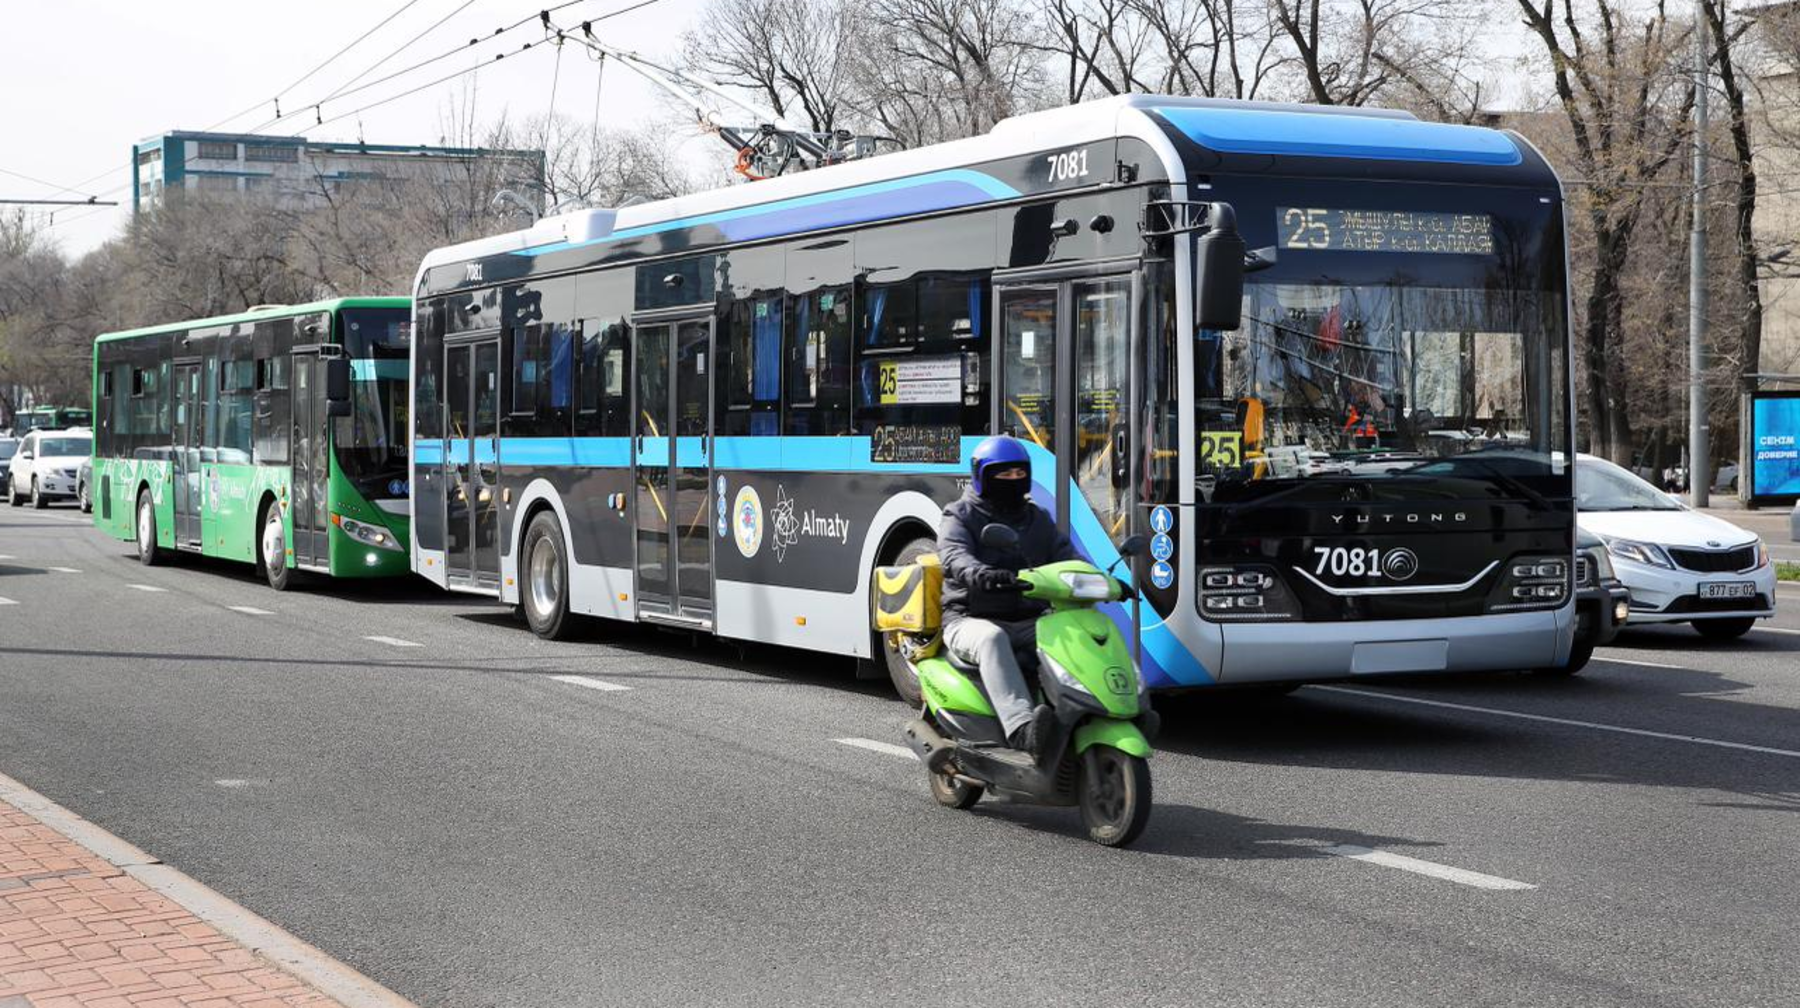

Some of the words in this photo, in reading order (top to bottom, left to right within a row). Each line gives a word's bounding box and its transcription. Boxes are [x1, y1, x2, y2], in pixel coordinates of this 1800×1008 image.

[1047, 149, 1089, 183] 7081
[1284, 208, 1330, 249] 25
[466, 263, 483, 281] 7081
[880, 367, 897, 396] 25
[873, 425, 896, 462] 25
[1201, 435, 1237, 469] 25
[801, 508, 849, 545] Almaty
[1331, 512, 1467, 524] YUTONG
[1313, 546, 1383, 577] 7081
[1709, 584, 1727, 597] 877
[1743, 583, 1755, 596] 02
